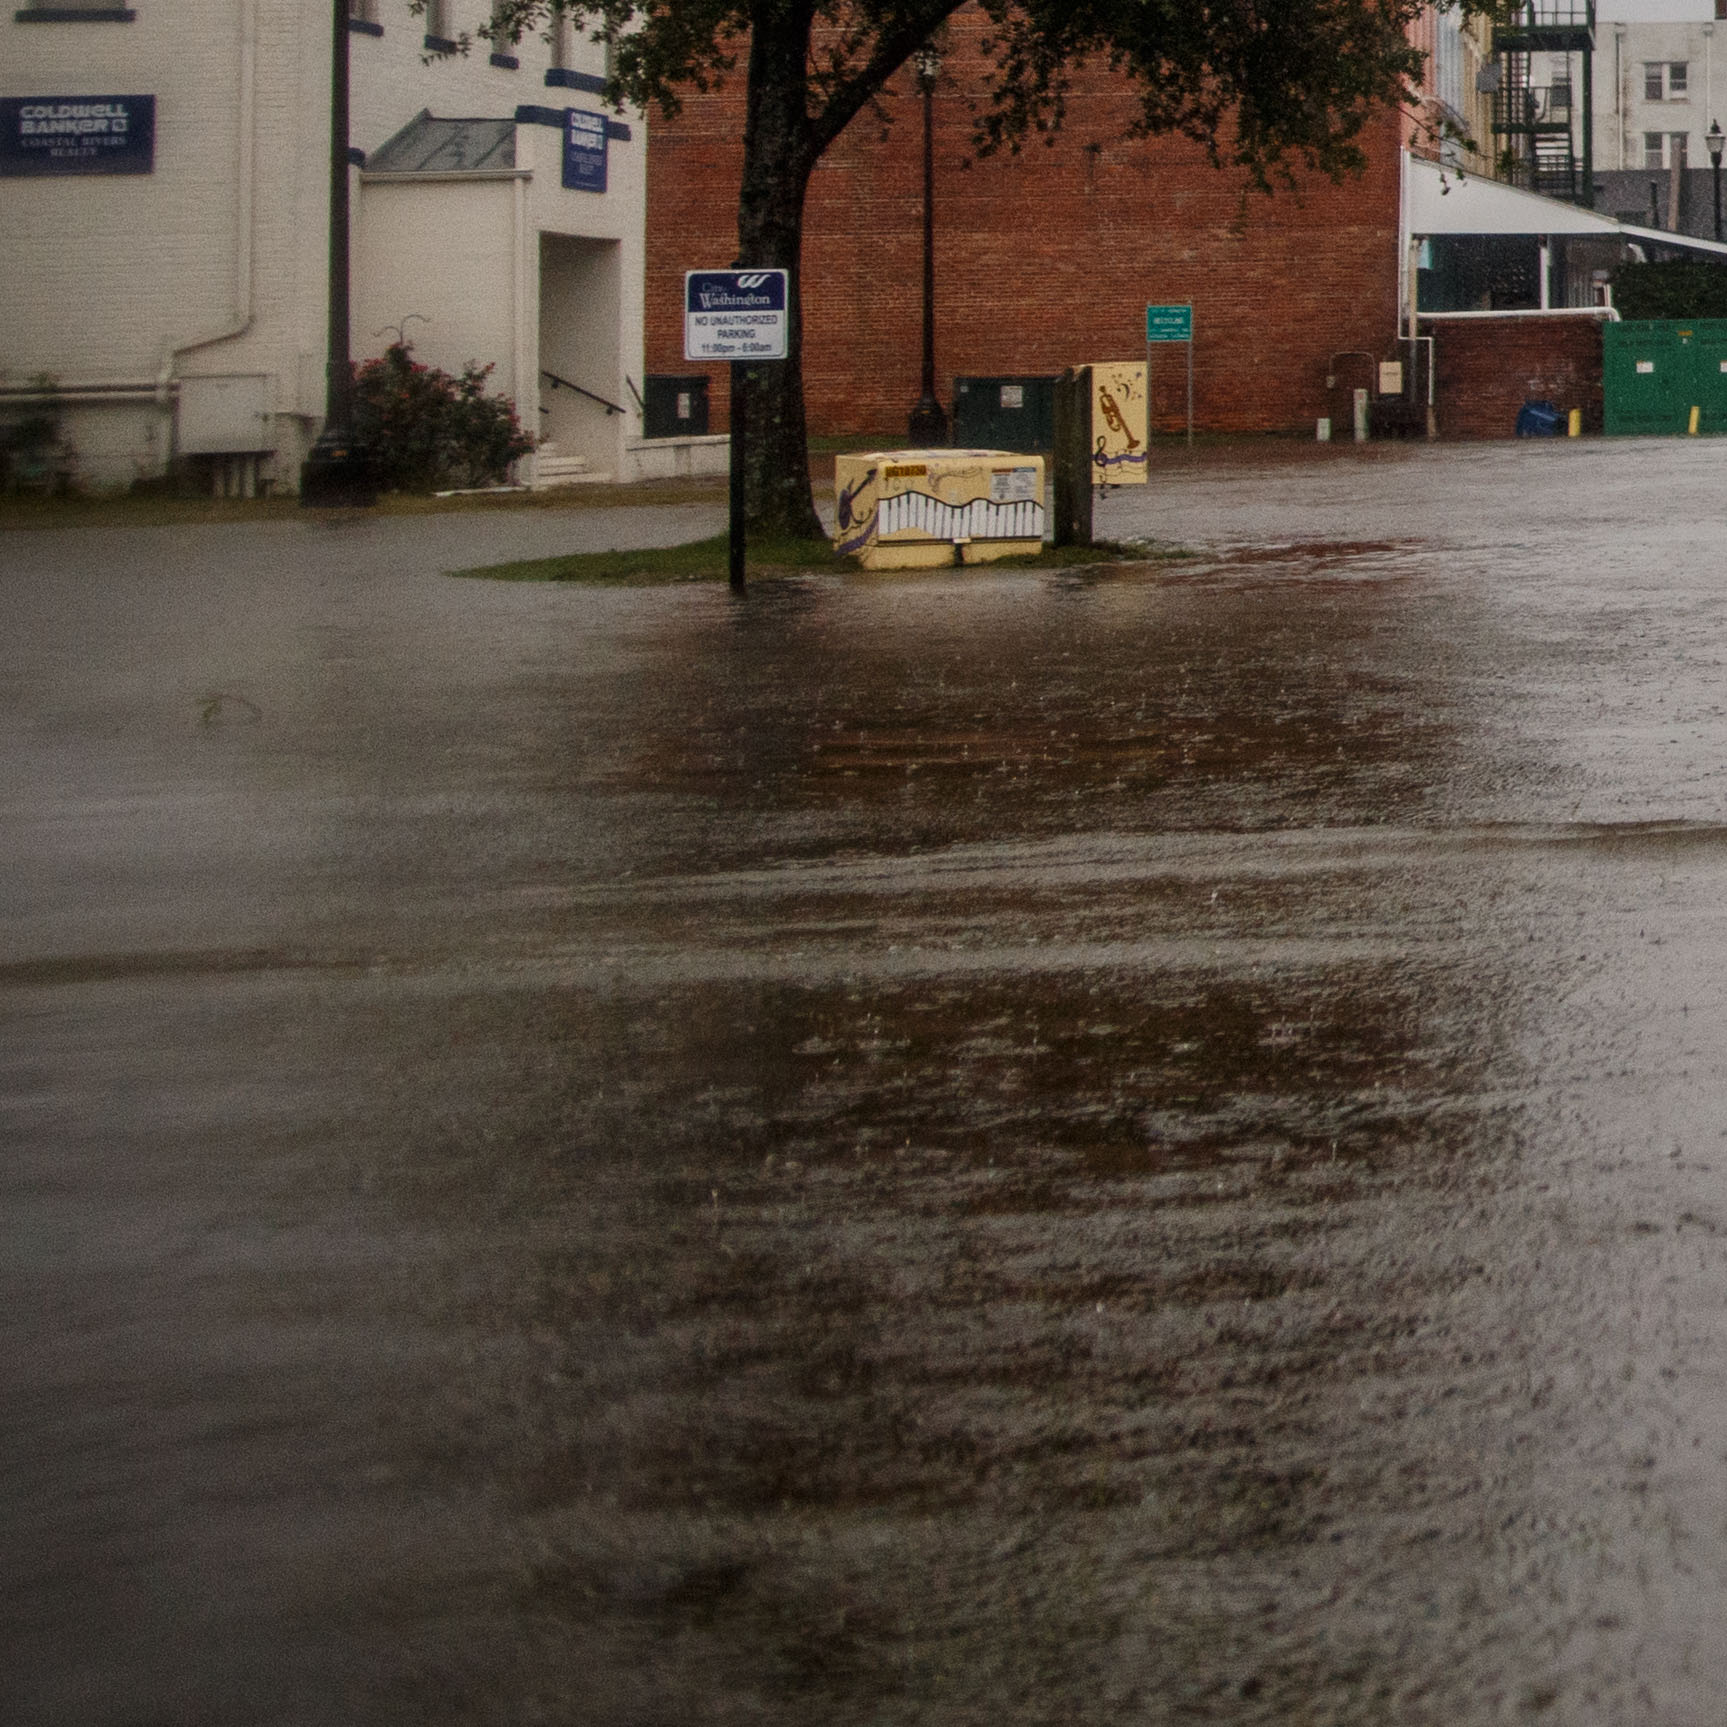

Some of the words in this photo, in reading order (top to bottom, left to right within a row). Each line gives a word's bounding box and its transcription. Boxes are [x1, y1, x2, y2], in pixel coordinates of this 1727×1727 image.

[20, 104, 129, 119] COLDWELL
[21, 119, 109, 135] BANKER
[699, 293, 771, 309] Washington
[695, 316, 708, 326] NO
[711, 315, 778, 326] UNAUTHORIZED
[717, 329, 756, 339] PARKING
